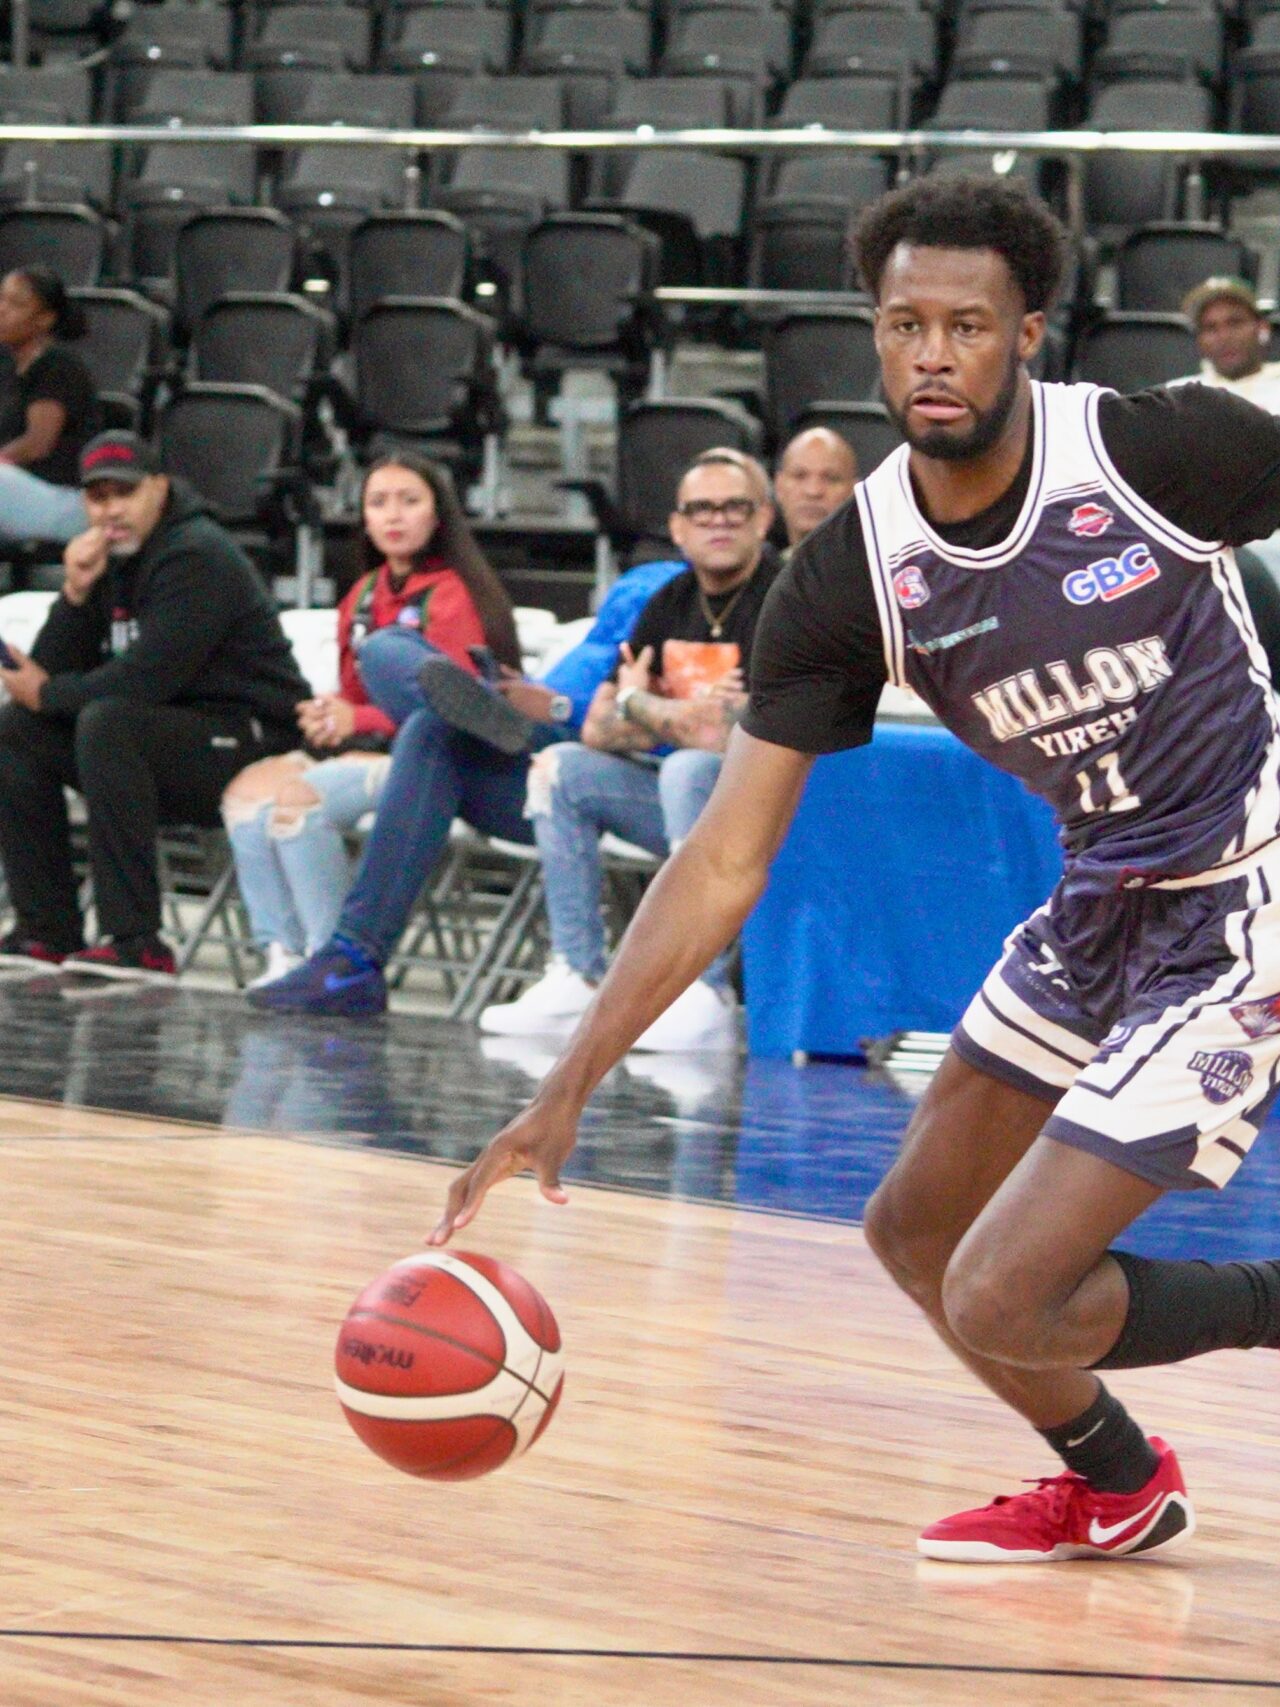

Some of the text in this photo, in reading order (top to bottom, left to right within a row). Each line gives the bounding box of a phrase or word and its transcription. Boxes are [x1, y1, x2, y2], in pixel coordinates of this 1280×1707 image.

[1062, 543, 1160, 605] GBC
[970, 635, 1173, 742] MILLON
[1031, 706, 1138, 757] YIREH
